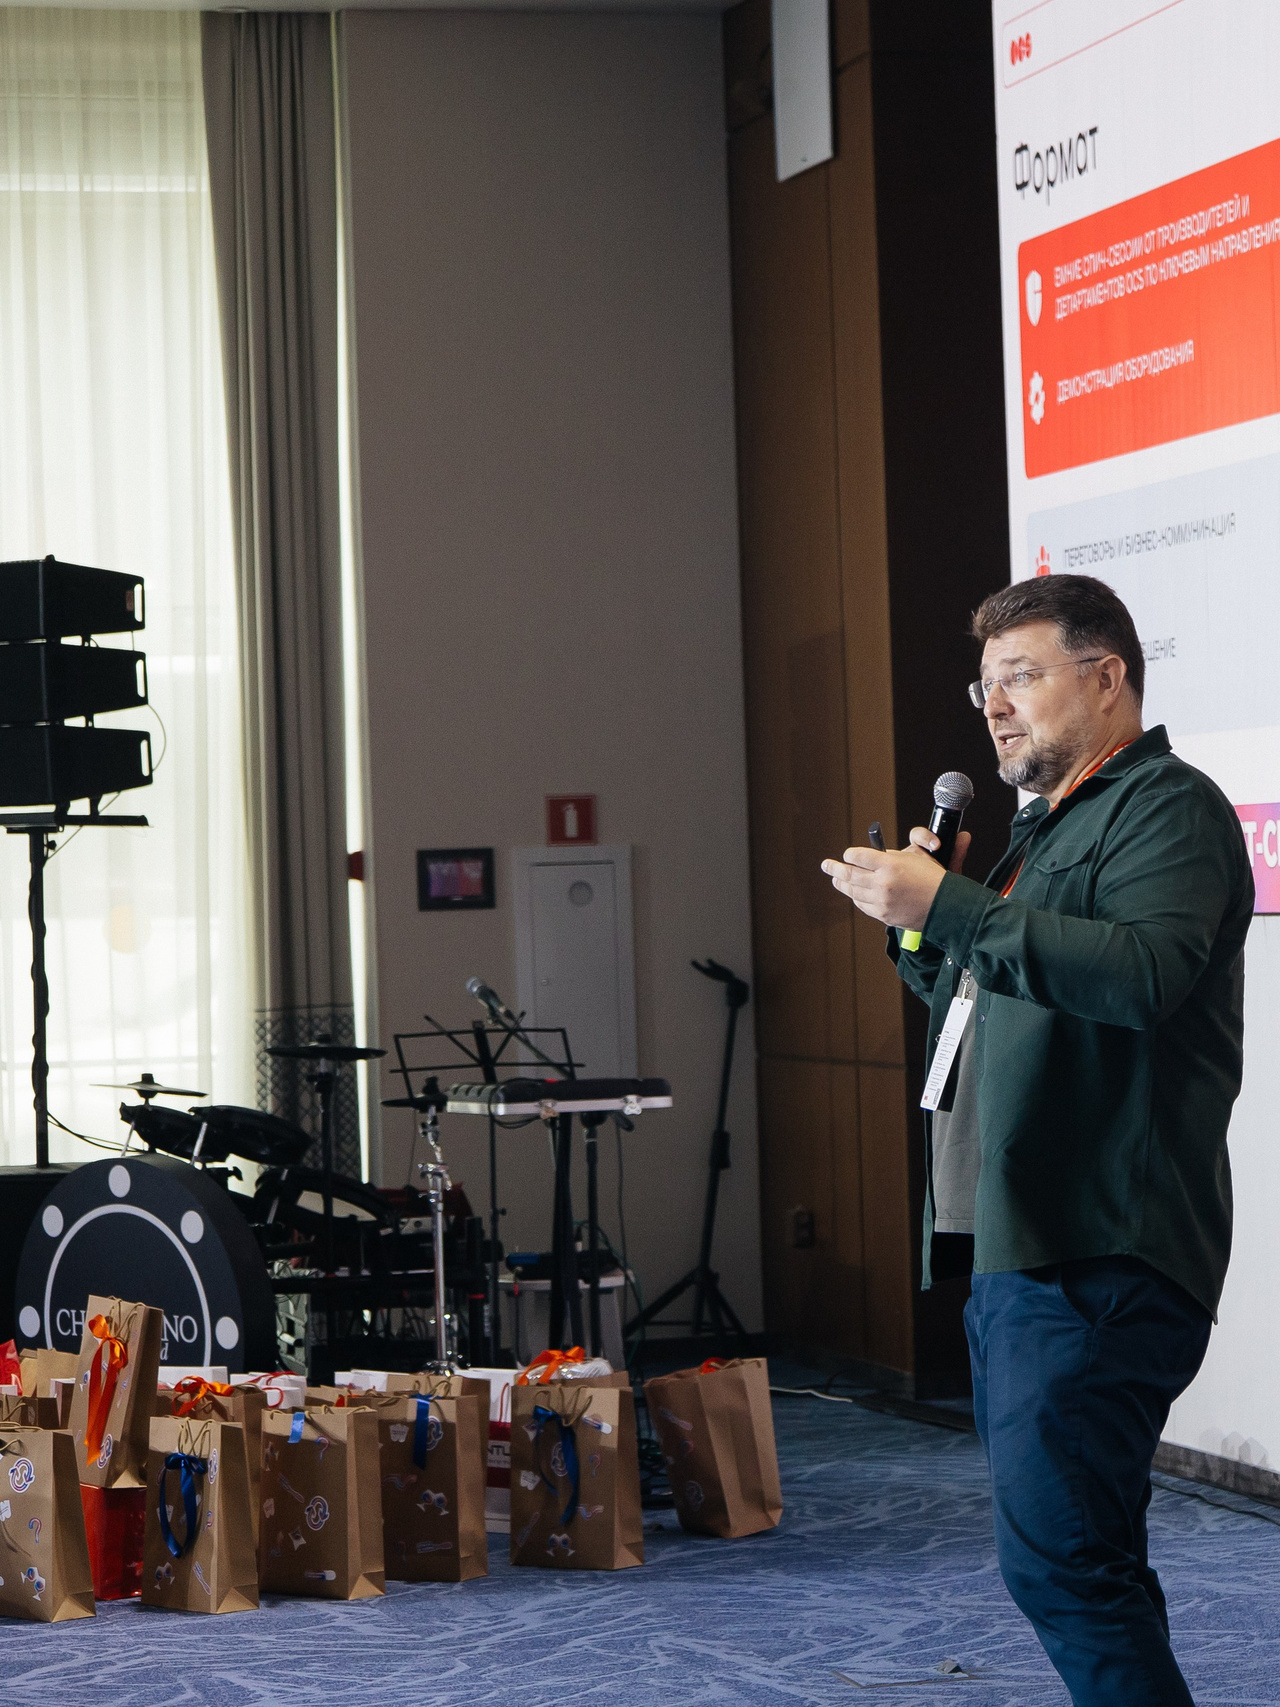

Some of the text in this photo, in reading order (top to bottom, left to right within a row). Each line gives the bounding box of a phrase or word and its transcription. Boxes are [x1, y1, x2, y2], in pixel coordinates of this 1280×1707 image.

[1015, 126, 1098, 206] Формат
[1143, 229, 1156, 255] ОТ
[1157, 193, 1241, 251] ПРОИЗВОДИТЕЛЕЙ
[1241, 194, 1250, 218] И
[1055, 274, 1125, 322] ДЕПАРТАМЕНТОВ
[1125, 267, 1145, 294] OCS
[1144, 262, 1159, 288] ПО
[1057, 339, 1195, 405] ДЕМОНСТРАЦИЯ ОБОРУДОВАНИЯ
[1064, 540, 1116, 568] ПЕРЕГОВОРЫ
[1126, 512, 1236, 557] БИЗНЕС-КОММУНИКАЦИЯ
[1142, 637, 1176, 662] БЩЕНИЕ
